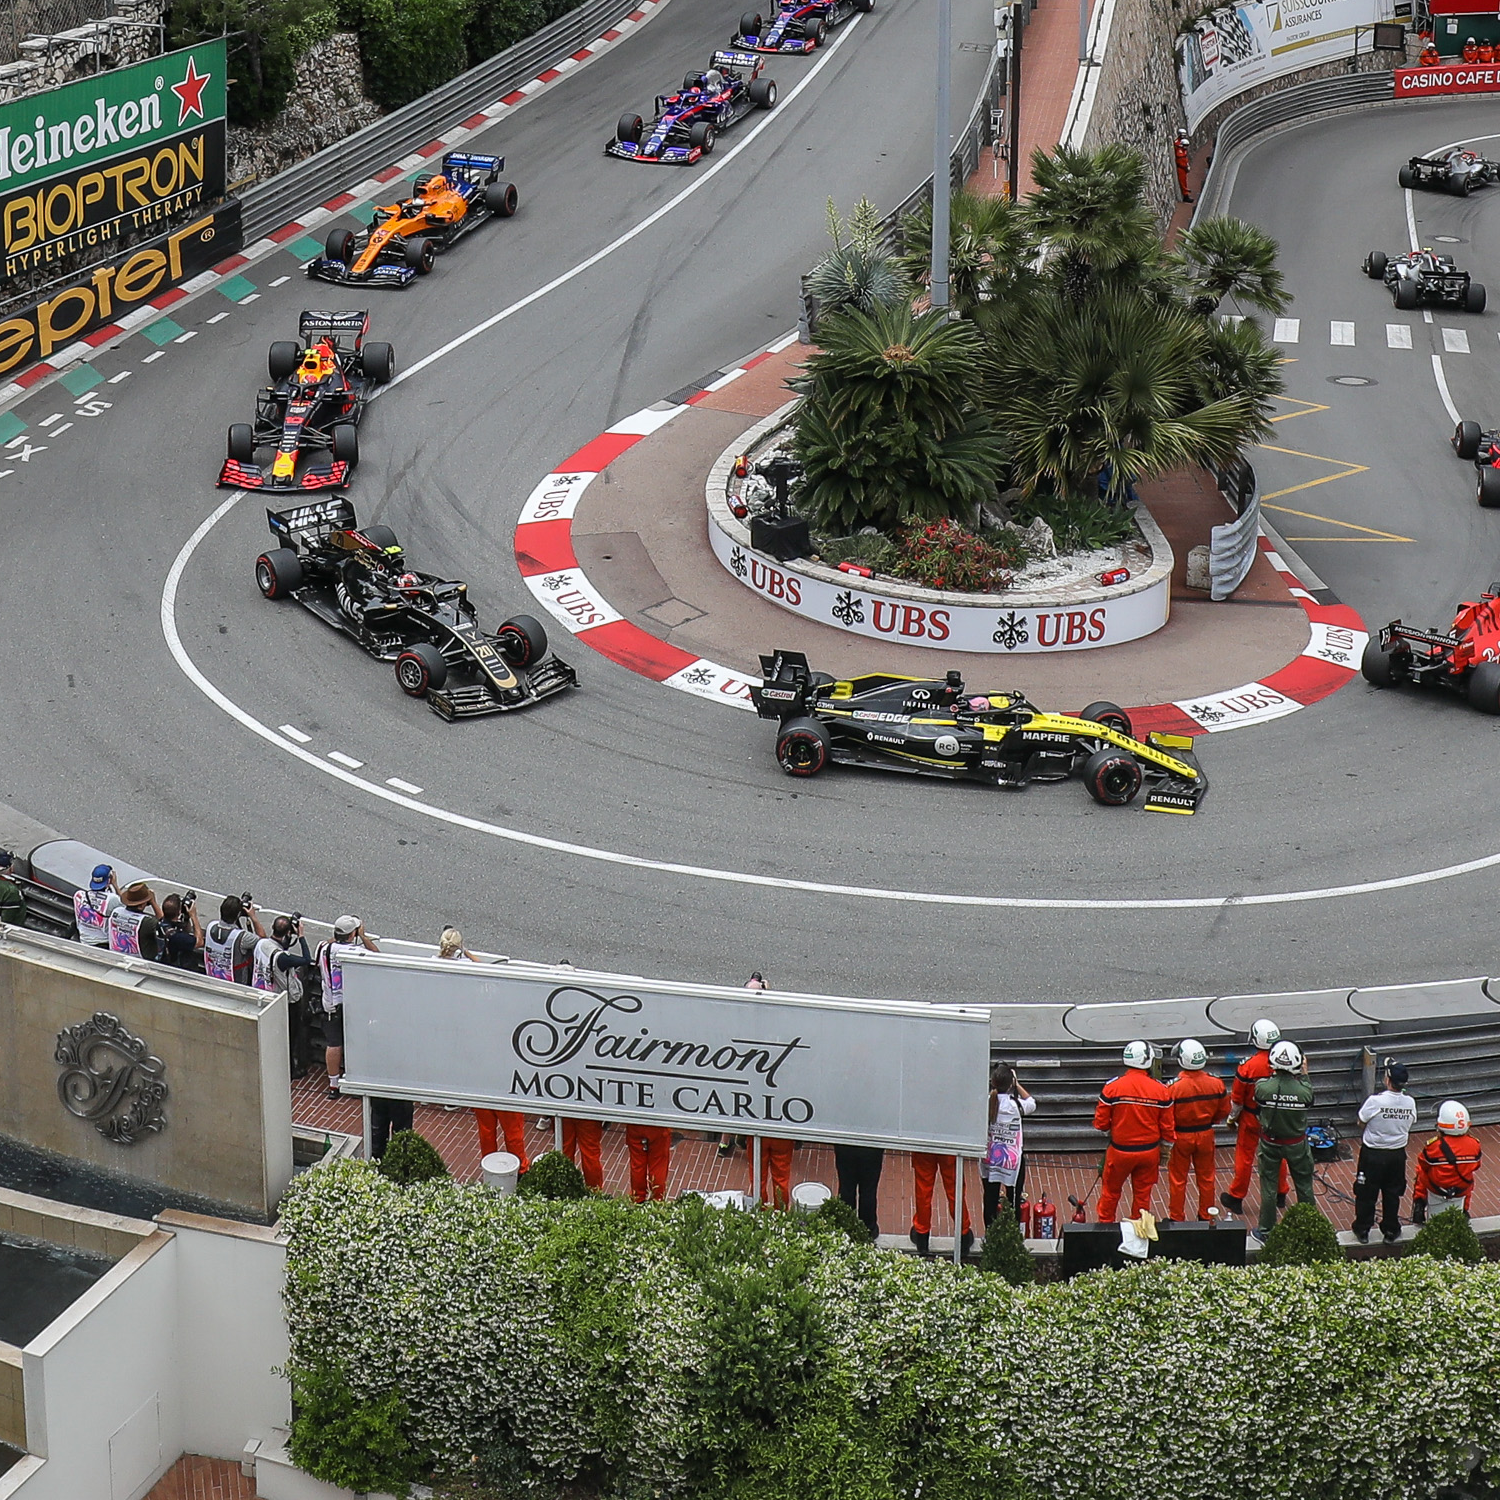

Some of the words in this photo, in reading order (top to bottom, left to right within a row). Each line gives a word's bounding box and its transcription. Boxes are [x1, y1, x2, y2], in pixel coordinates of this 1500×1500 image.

[1284, 9, 1323, 30] ASSURANCES
[1401, 72, 1453, 90] CASINO
[1455, 70, 1494, 86] CAFE
[3, 134, 204, 255] BIOPTRON
[5, 218, 122, 278] HYPERLIGHT
[132, 186, 204, 230] THERAPY
[302, 319, 332, 327] ASTON
[533, 488, 570, 520] UBS
[287, 500, 343, 529] HAAS
[749, 559, 803, 607] UBS
[556, 590, 607, 626] UBS
[871, 599, 951, 642] UBS
[1036, 608, 1107, 648] UBS
[1325, 626, 1355, 651] UBS
[1394, 625, 1426, 639] MISSION
[1425, 633, 1460, 646] WINNOW
[475, 644, 493, 659] 20
[769, 690, 794, 700] Castrol
[1216, 689, 1285, 715] UBS
[902, 700, 941, 711] INFINITI
[859, 711, 879, 721] Castrol
[878, 712, 912, 724] EDGE
[1050, 718, 1105, 732] RENAULT
[874, 734, 906, 746] RENAULT
[1022, 731, 1071, 744] MAPFRE
[1150, 795, 1196, 807] RENAULT
[511, 984, 811, 1089] Fairmont
[509, 1068, 656, 1110] MONTE
[670, 1086, 815, 1124] CARLO
[1382, 1112, 1411, 1121] CIRCUIT
[1457, 1118, 1466, 1130] S
[994, 1135, 1015, 1145] PHOTO
